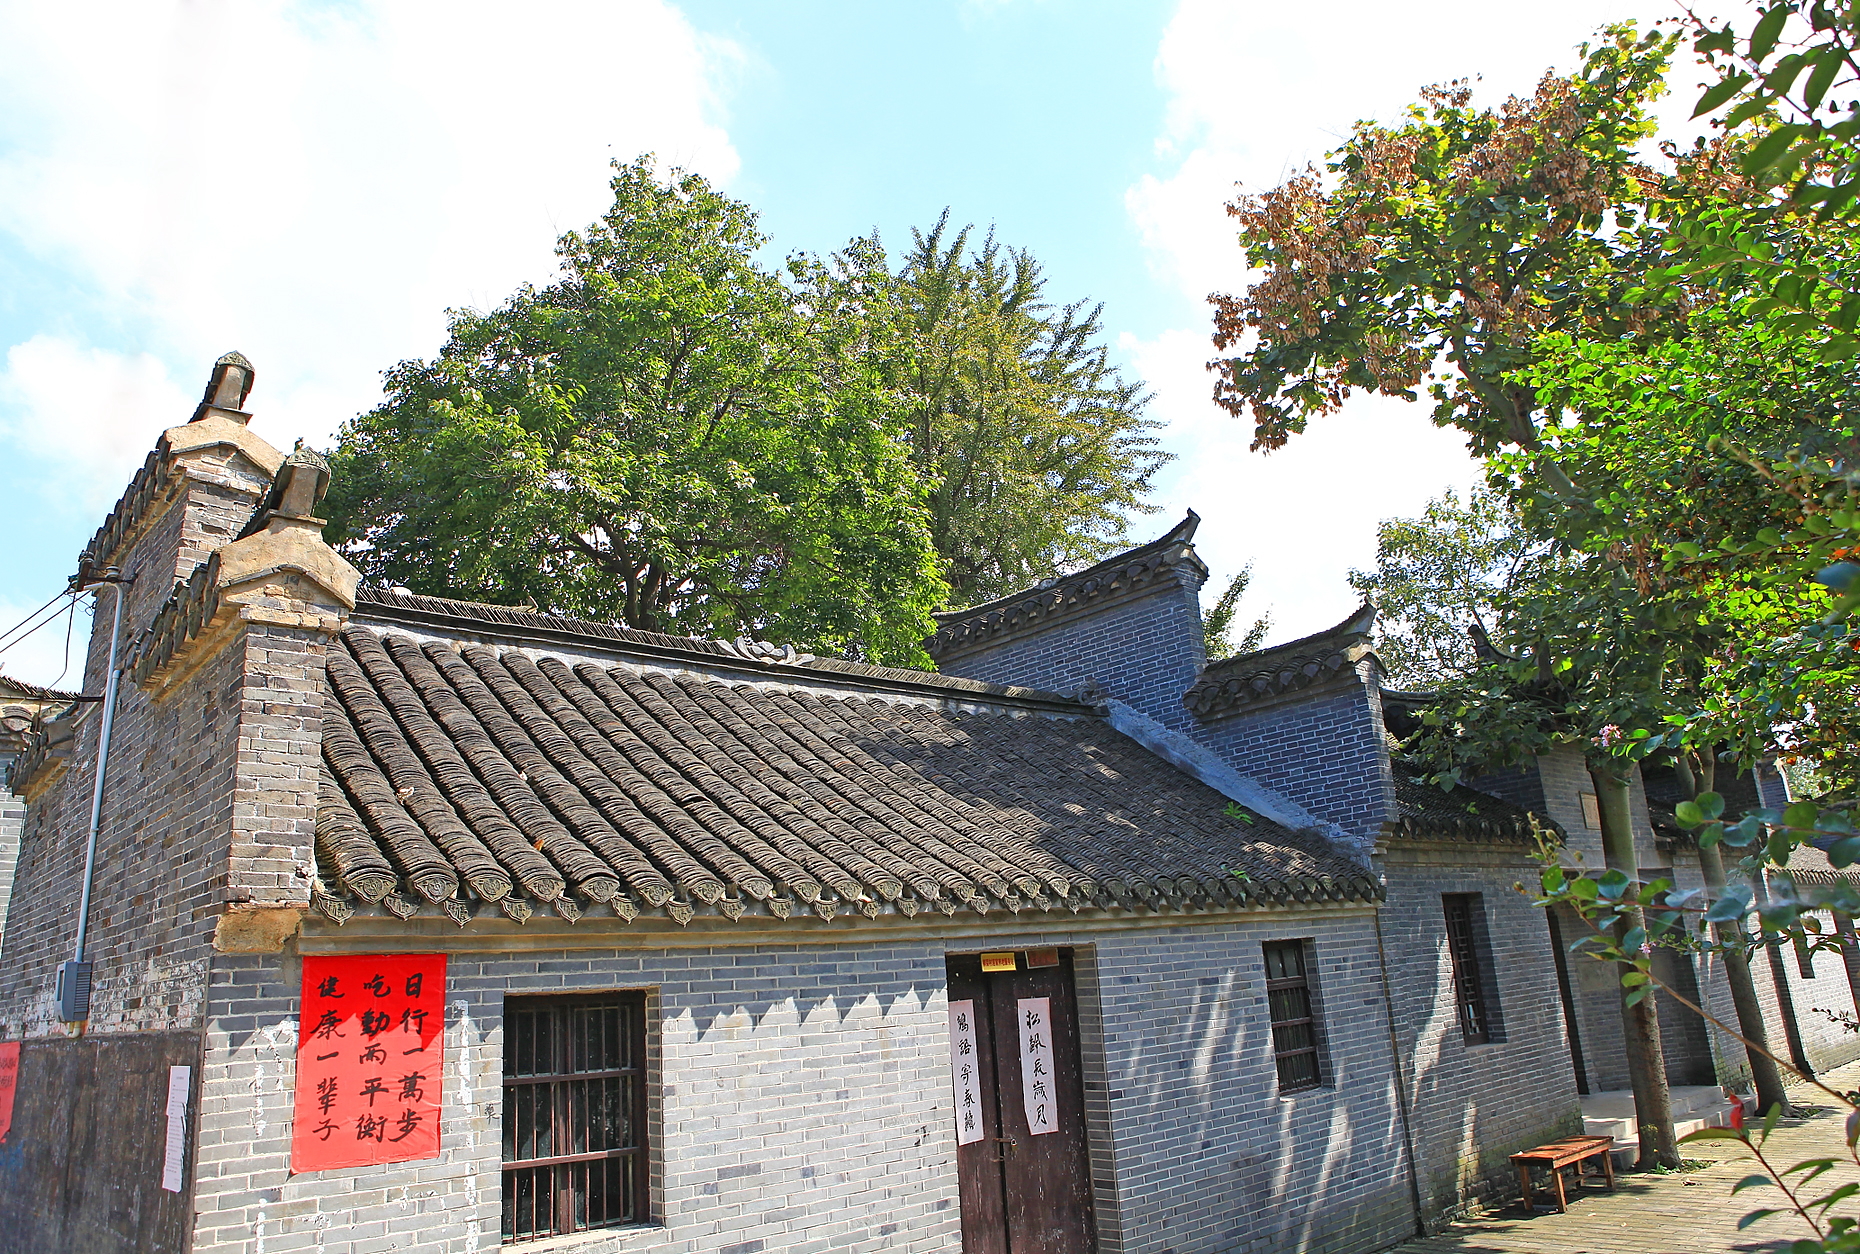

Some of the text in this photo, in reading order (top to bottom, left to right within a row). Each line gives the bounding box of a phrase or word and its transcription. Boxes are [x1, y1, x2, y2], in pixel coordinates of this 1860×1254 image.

[309, 975, 346, 1142] 健康一輩子
[387, 972, 429, 1143] 日行一萬步
